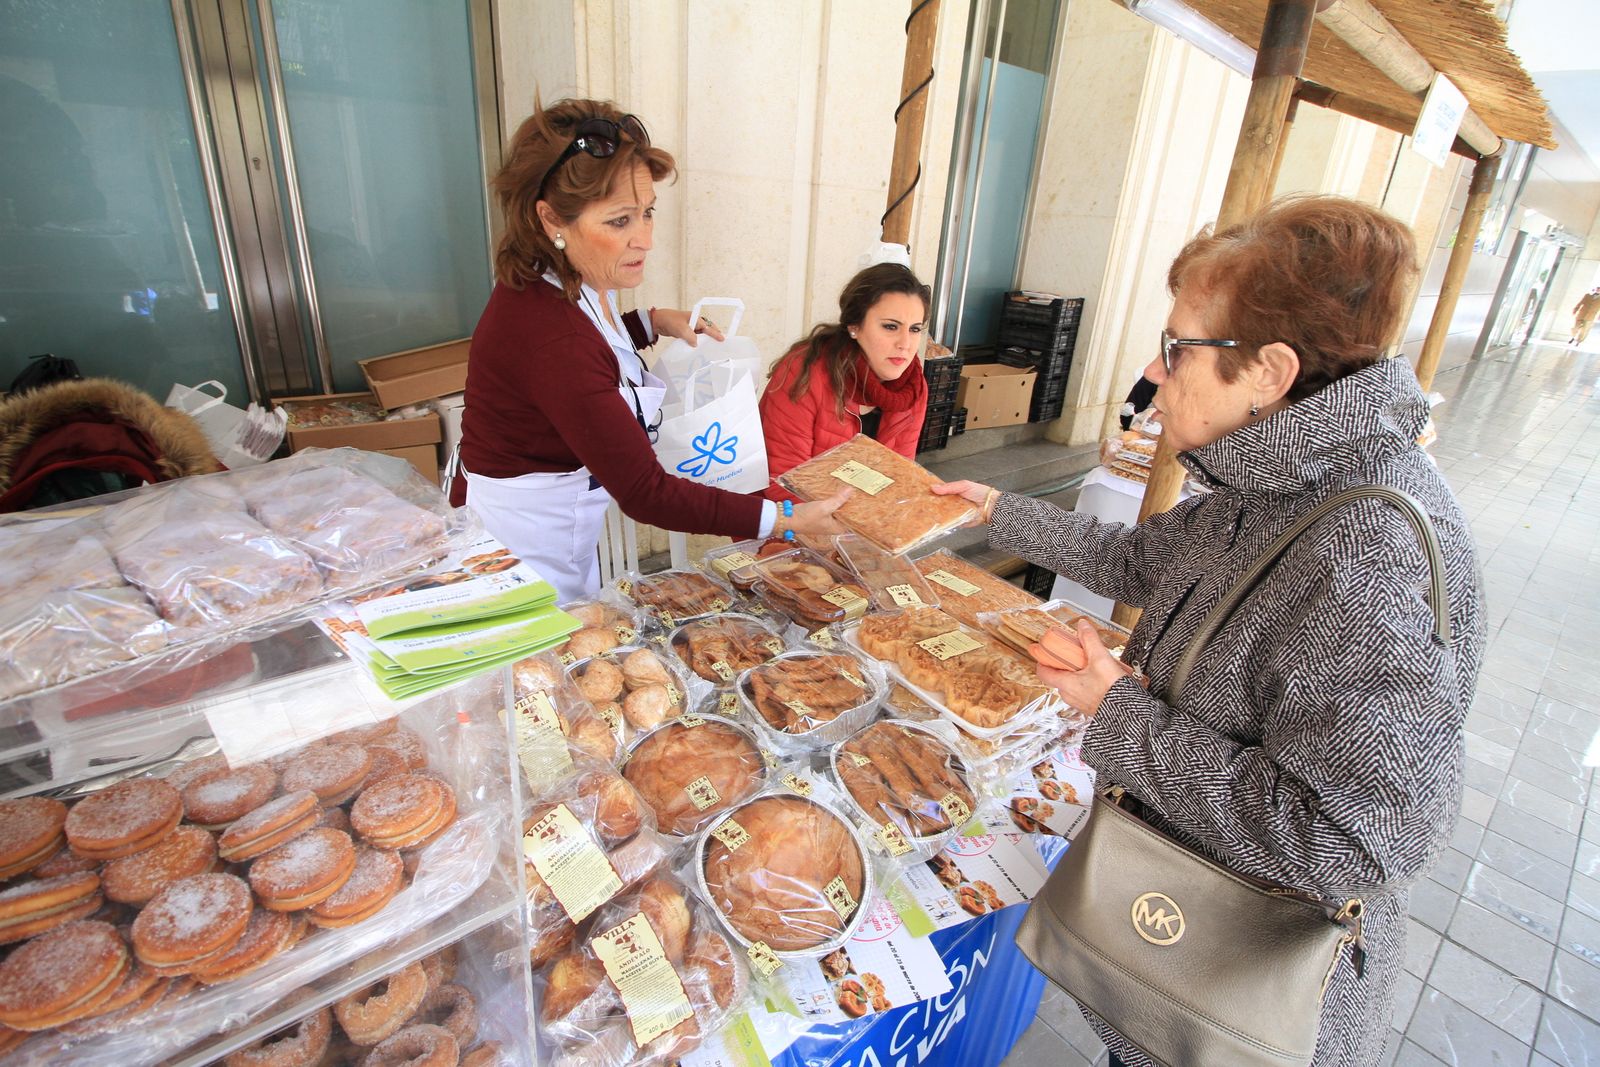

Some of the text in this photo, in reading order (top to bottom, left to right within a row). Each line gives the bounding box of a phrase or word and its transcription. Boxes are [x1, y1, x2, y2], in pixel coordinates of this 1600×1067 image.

[687, 777, 707, 791] VILLA
[526, 813, 558, 838] VILLA
[730, 834, 751, 850] VILLA
[550, 842, 580, 868] MAGDALENAS
[825, 877, 842, 894] VILLA
[1136, 899, 1181, 938] MK
[602, 920, 636, 941] VILLA
[618, 947, 651, 970] ANDEVALO
[620, 955, 653, 975] MAGDALENAS
[625, 968, 642, 979] ACEITE
[648, 1025, 659, 1034] 400
